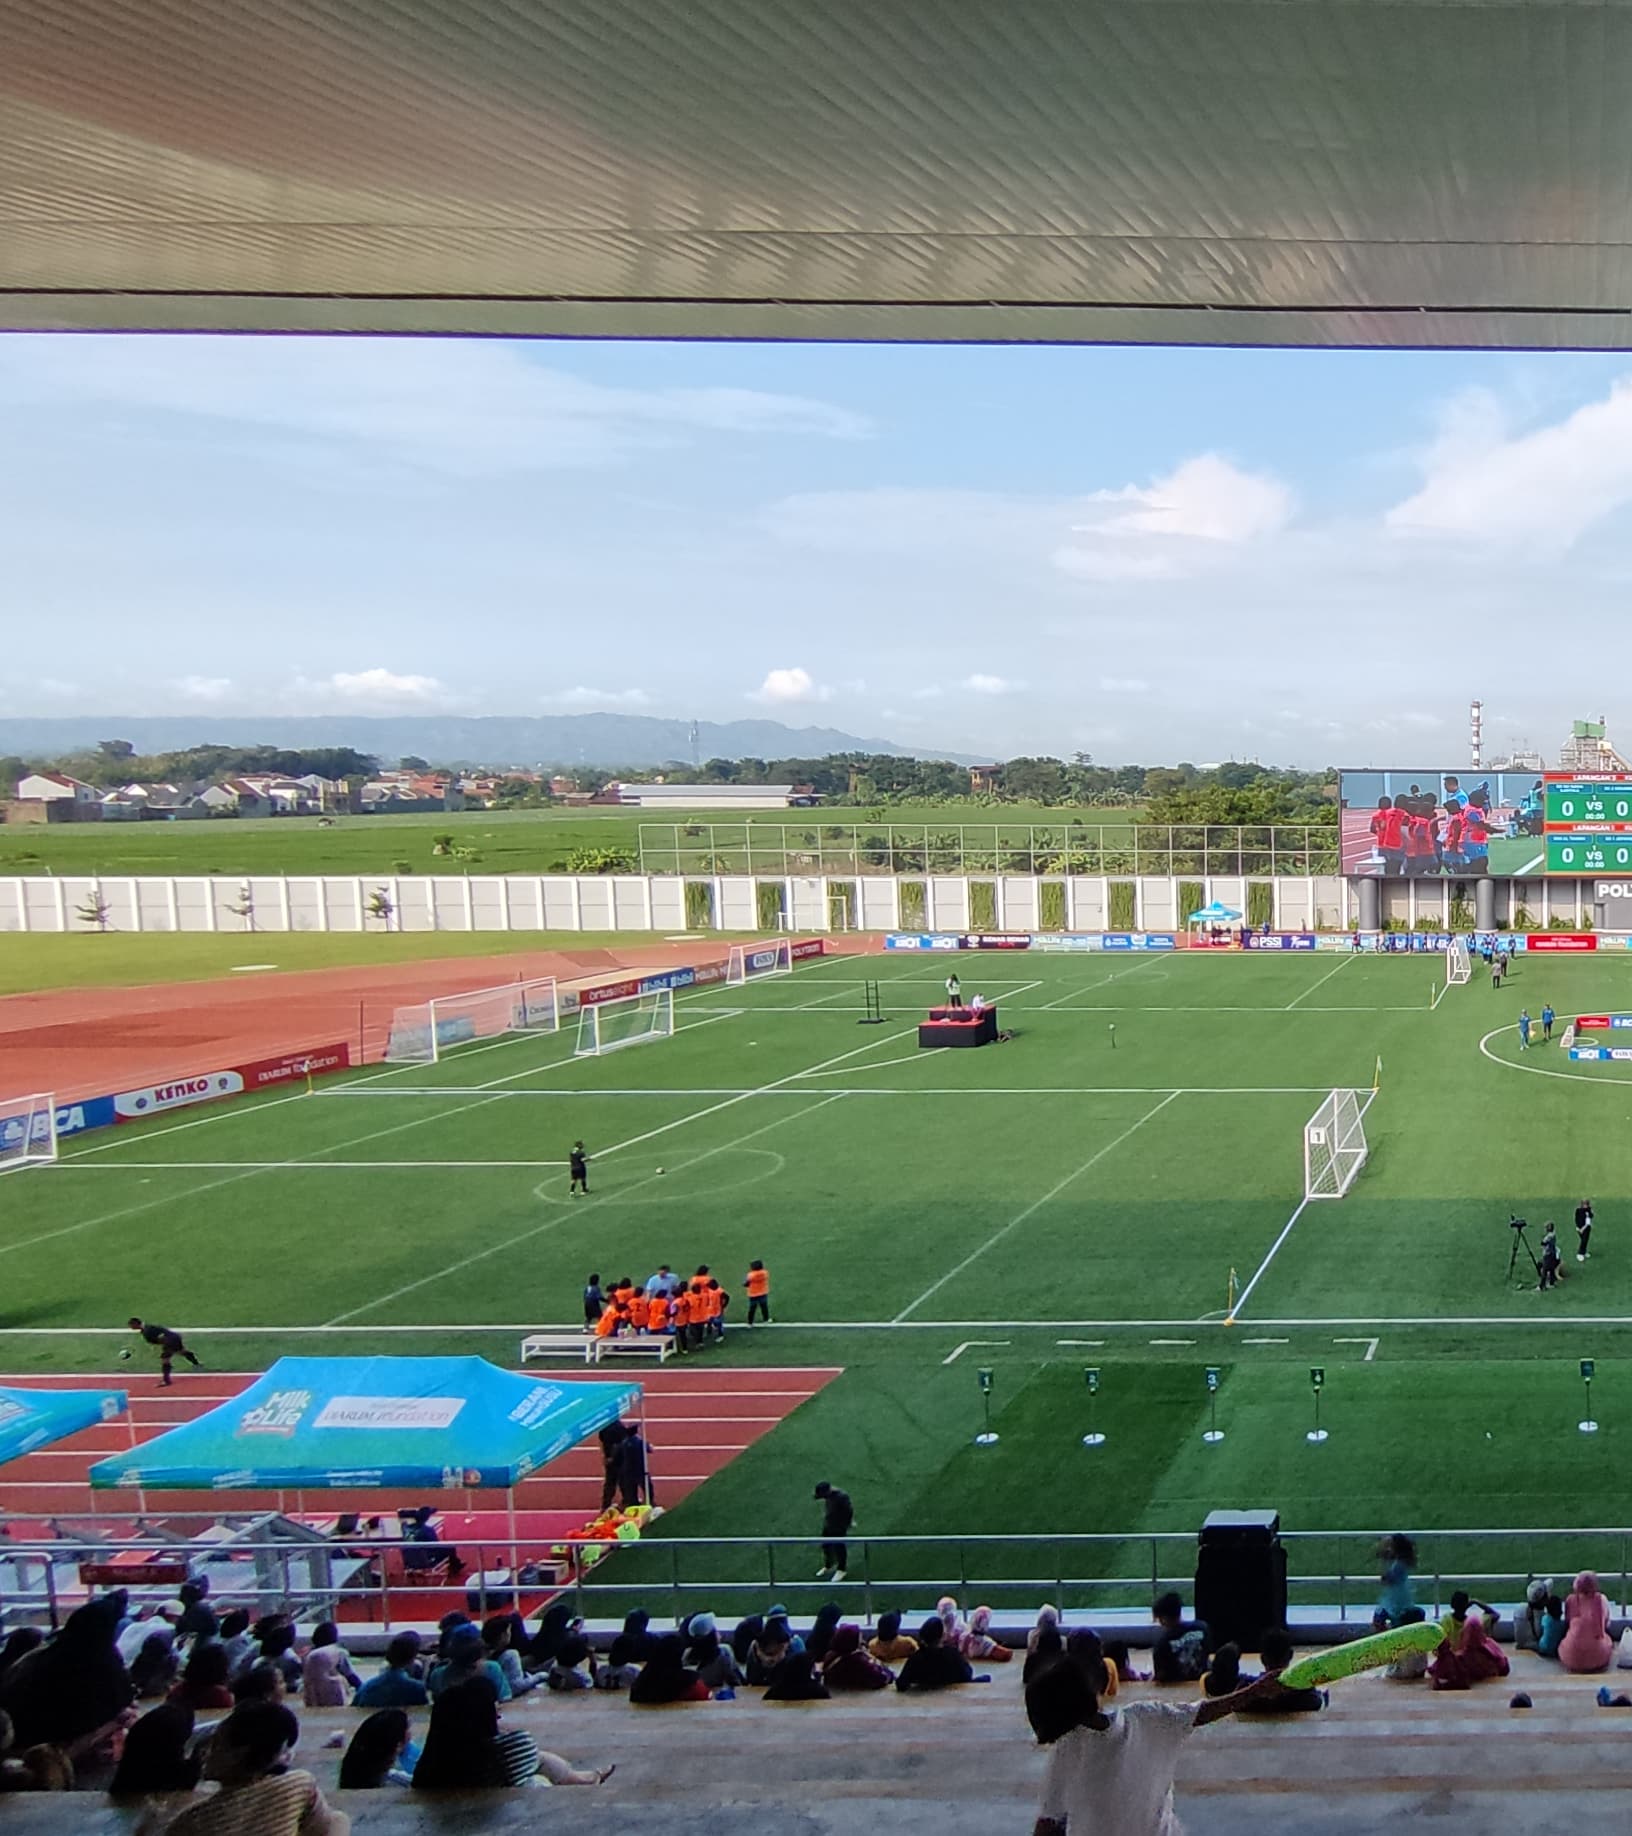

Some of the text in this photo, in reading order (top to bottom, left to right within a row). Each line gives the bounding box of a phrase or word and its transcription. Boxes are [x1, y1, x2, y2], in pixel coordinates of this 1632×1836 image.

[1561, 801, 1629, 816] 0 VS 0
[1561, 848, 1629, 863] 0 VS 0
[154, 1079, 208, 1102] KENKO
[31, 1105, 85, 1139] BCA
[1208, 1374, 1216, 1384] 3
[266, 1389, 311, 1409] Milk
[262, 1408, 303, 1425] Life
